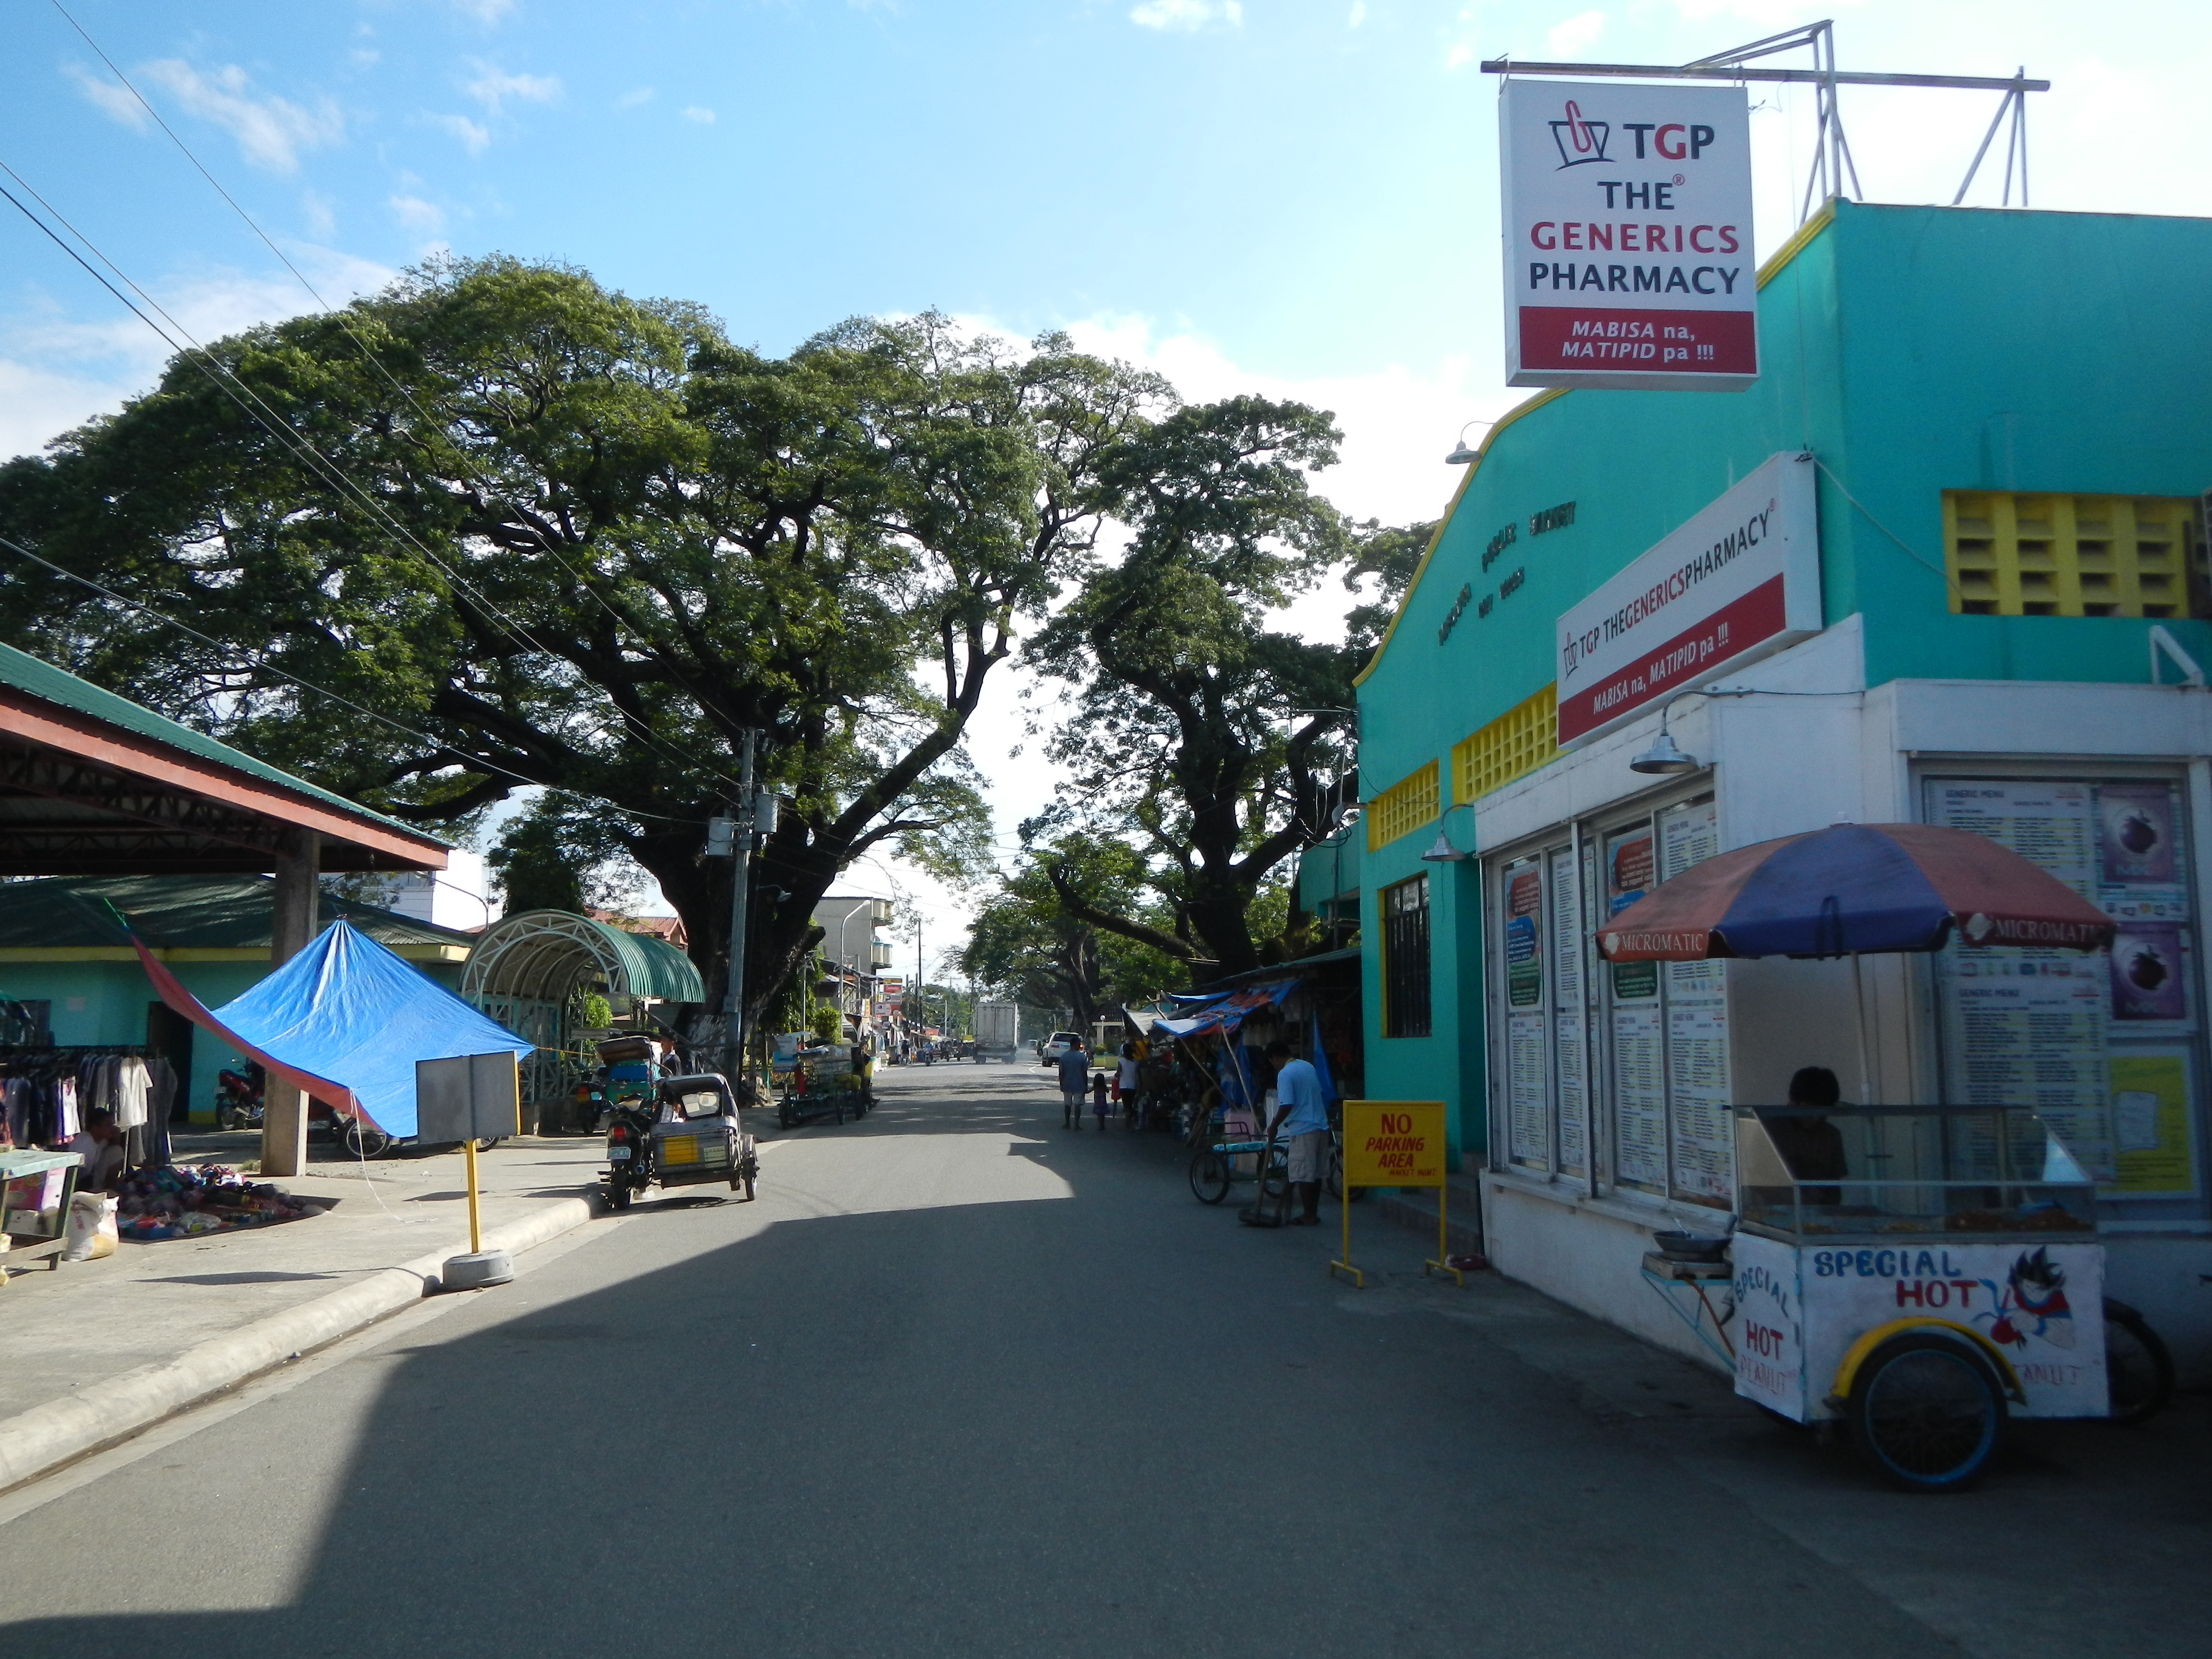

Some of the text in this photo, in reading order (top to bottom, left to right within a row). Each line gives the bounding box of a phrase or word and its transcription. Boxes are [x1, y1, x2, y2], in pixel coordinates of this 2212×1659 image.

[1623, 123, 1715, 160] TGP
[1597, 181, 1675, 210] THE
[1530, 221, 1739, 254] GENERICS
[1529, 263, 1740, 295] PHARMACY
[1572, 321, 1695, 341] MABISA na,
[1561, 341, 1656, 360] MATIPID
[1663, 346, 1689, 363] pa
[1579, 626, 1599, 659] TGP
[1593, 680, 1628, 714] MABISA
[1631, 676, 1647, 693] na,
[1649, 641, 1696, 685] MATIPID
[1700, 637, 1715, 662] pa
[1622, 933, 1703, 951] MICROMATIC
[1381, 1113, 1412, 1134] NO
[1365, 1137, 1425, 1152] PARKING
[1378, 1153, 1414, 1168] AREA
[1815, 1250, 1962, 1278] SPECIAL
[1734, 1266, 1789, 1318] SPECIAL
[1895, 1279, 1978, 1309] HOT
[1745, 1318, 1784, 1361] HOT
[2011, 1363, 2080, 1385] ANUT
